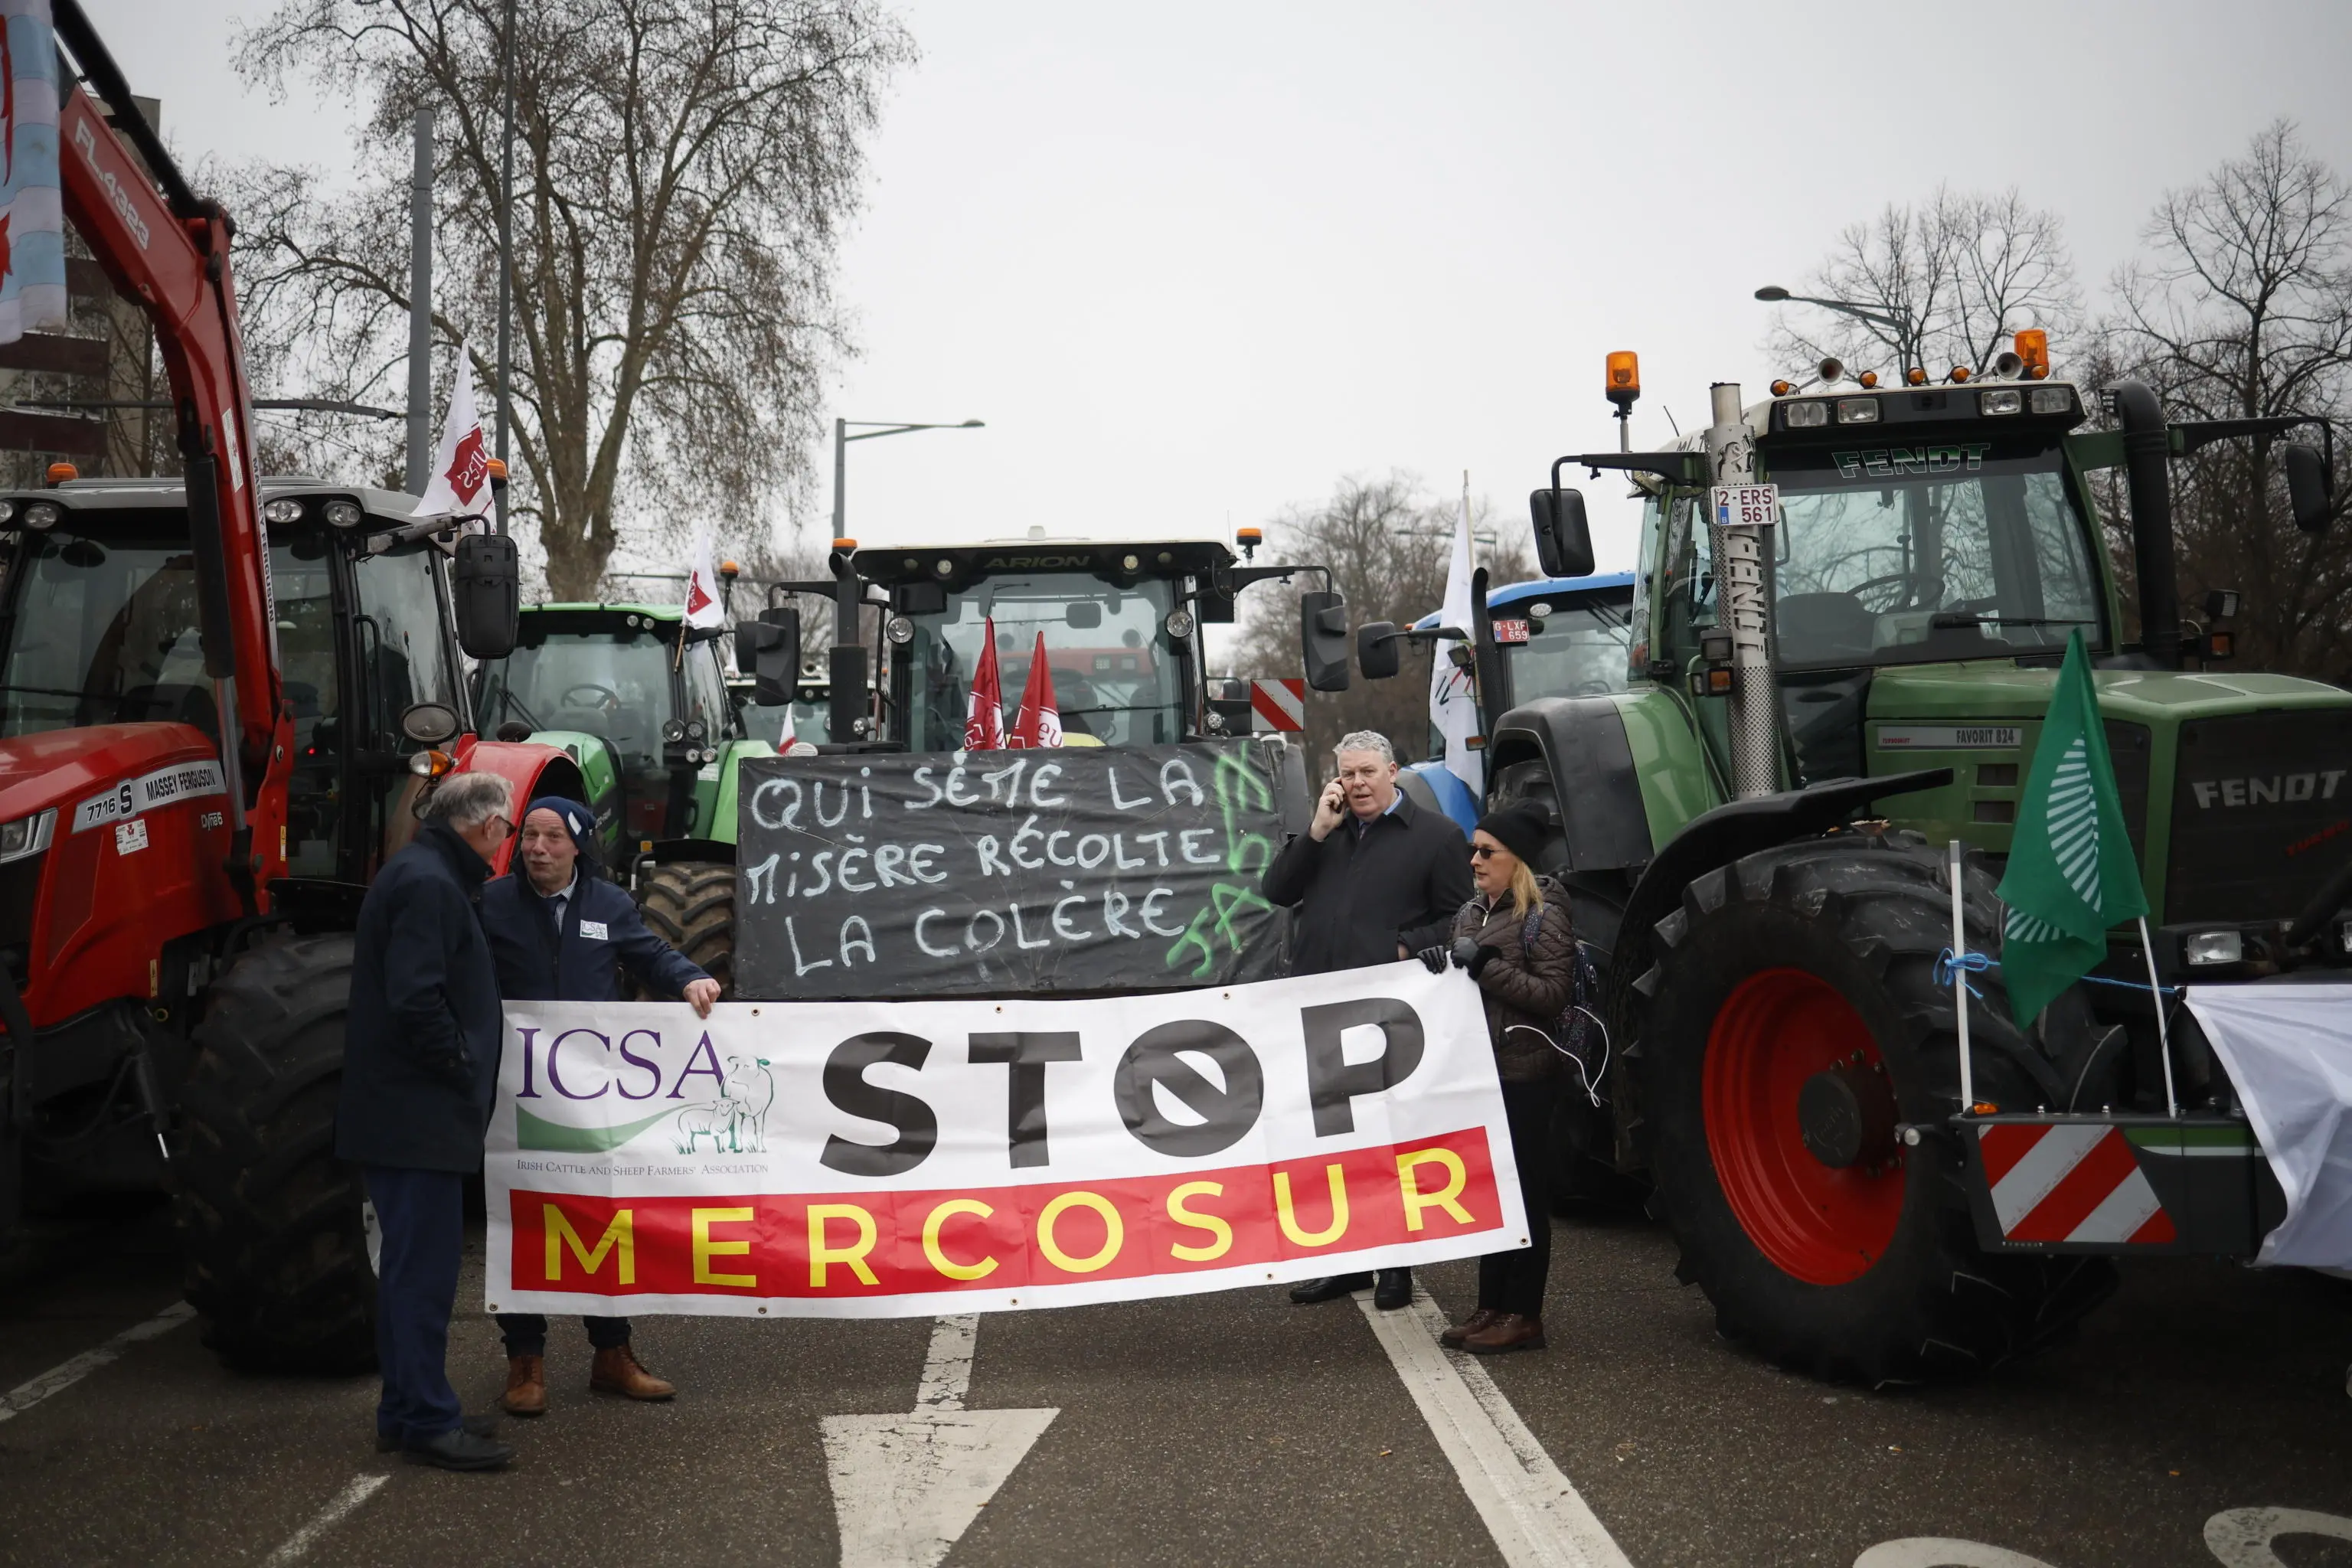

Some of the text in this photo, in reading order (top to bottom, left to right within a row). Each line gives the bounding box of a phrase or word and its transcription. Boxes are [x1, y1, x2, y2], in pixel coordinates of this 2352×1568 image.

[1831, 443, 1991, 479] FENDT
[1741, 506, 1772, 524] 561
[253, 457, 275, 622] MASSEY FERGUSON
[984, 555, 1090, 569] ARION
[1508, 630, 1528, 640] 659
[1955, 728, 1994, 744] FAVORIT
[1995, 728, 2014, 744] 824
[87, 768, 216, 823] 7716 S MASSEY FERGUSON
[1108, 759, 1204, 810] LA
[2191, 769, 2347, 809] FENDT
[977, 815, 1221, 877] RÉCOLTE
[785, 880, 1185, 976] LA COLÈRE
[514, 996, 1426, 1177] ICSA STOP
[517, 1158, 543, 1171] IRISH
[545, 1161, 586, 1175] CATTLE
[588, 1166, 611, 1175] AND
[612, 1165, 645, 1176] SHEEP
[701, 1163, 769, 1174] ASSOCIATION
[542, 1147, 1476, 1288] MERCOSUR
